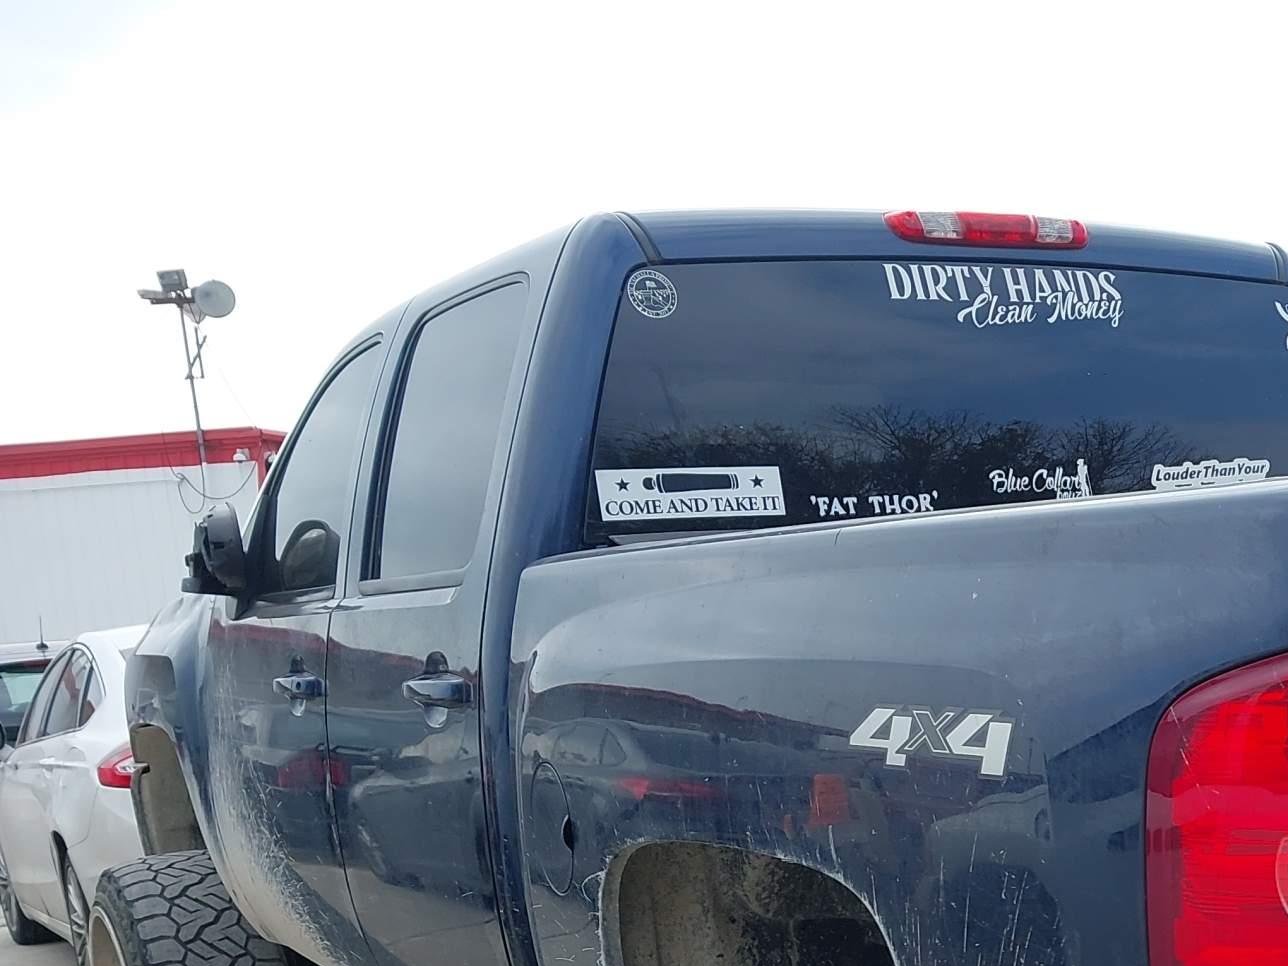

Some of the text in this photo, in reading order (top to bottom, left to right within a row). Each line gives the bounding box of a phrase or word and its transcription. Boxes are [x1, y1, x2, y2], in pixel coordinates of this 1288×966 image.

[882, 263, 1121, 303] DIRTY HANDS
[957, 290, 1124, 328] Clean Money
[989, 466, 1081, 493] Blue Collar
[605, 496, 779, 516] COME AND TAKE IT
